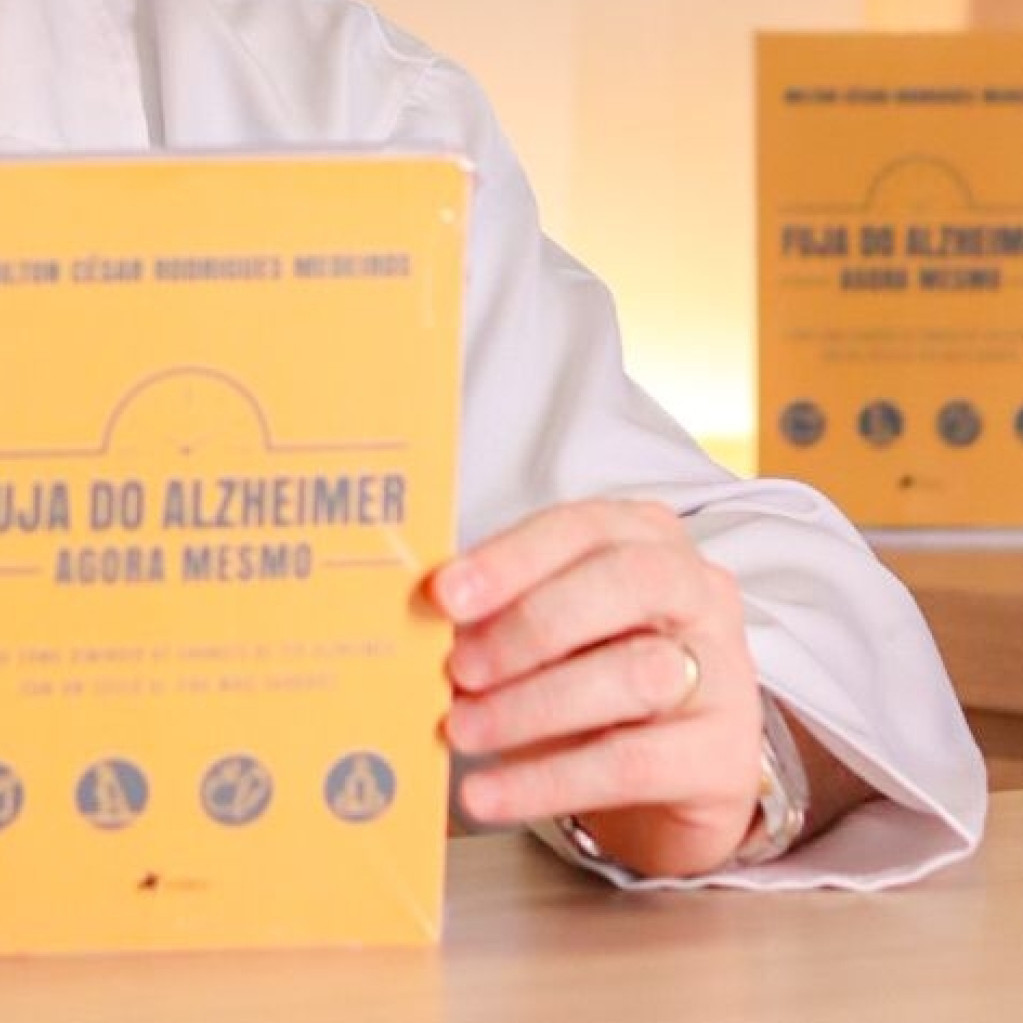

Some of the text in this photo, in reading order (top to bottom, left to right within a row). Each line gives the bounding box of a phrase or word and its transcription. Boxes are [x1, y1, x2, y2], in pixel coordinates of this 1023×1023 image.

[89, 479, 145, 532] DO
[162, 475, 406, 530] ALZHEIMER
[55, 543, 312, 585] AGORA MESMO
